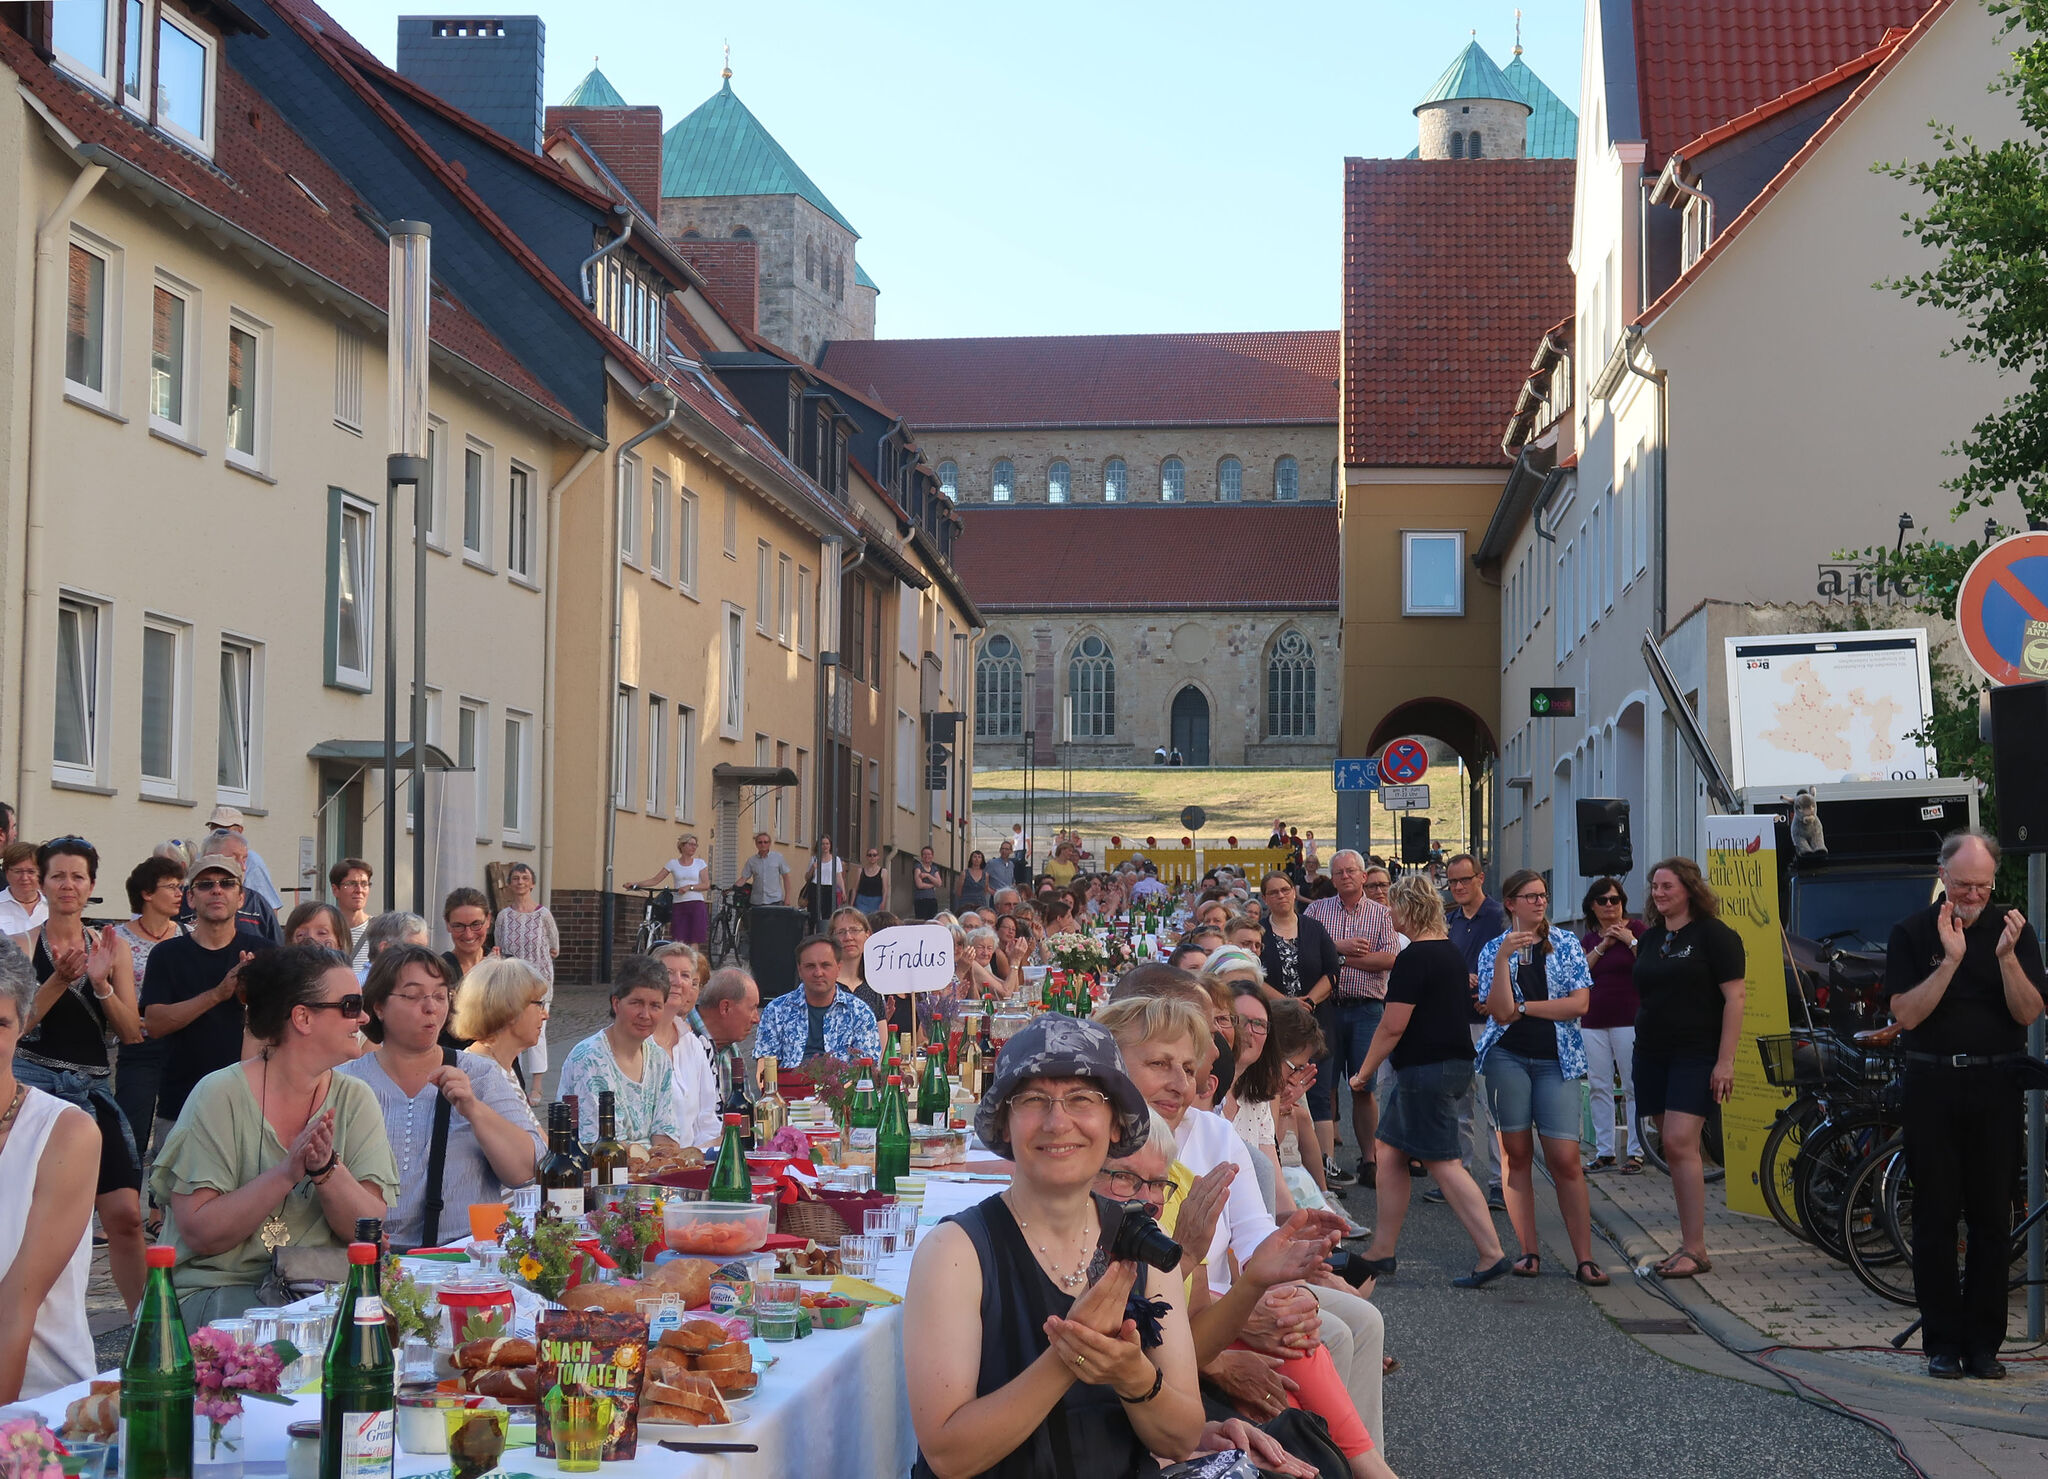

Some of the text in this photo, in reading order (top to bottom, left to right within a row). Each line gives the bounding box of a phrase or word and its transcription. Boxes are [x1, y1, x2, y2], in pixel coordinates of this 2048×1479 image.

[2026, 627, 2048, 637] ANT
[1746, 662, 1770, 670] Brot
[1923, 807, 1941, 816] Brot
[1708, 831, 1750, 858] Lernen
[1710, 860, 1763, 887] eine Welt
[1726, 889, 1751, 917] sein
[872, 939, 946, 971] Findus
[541, 1338, 601, 1363] SNACK-
[556, 1363, 629, 1389] TOMATEN
